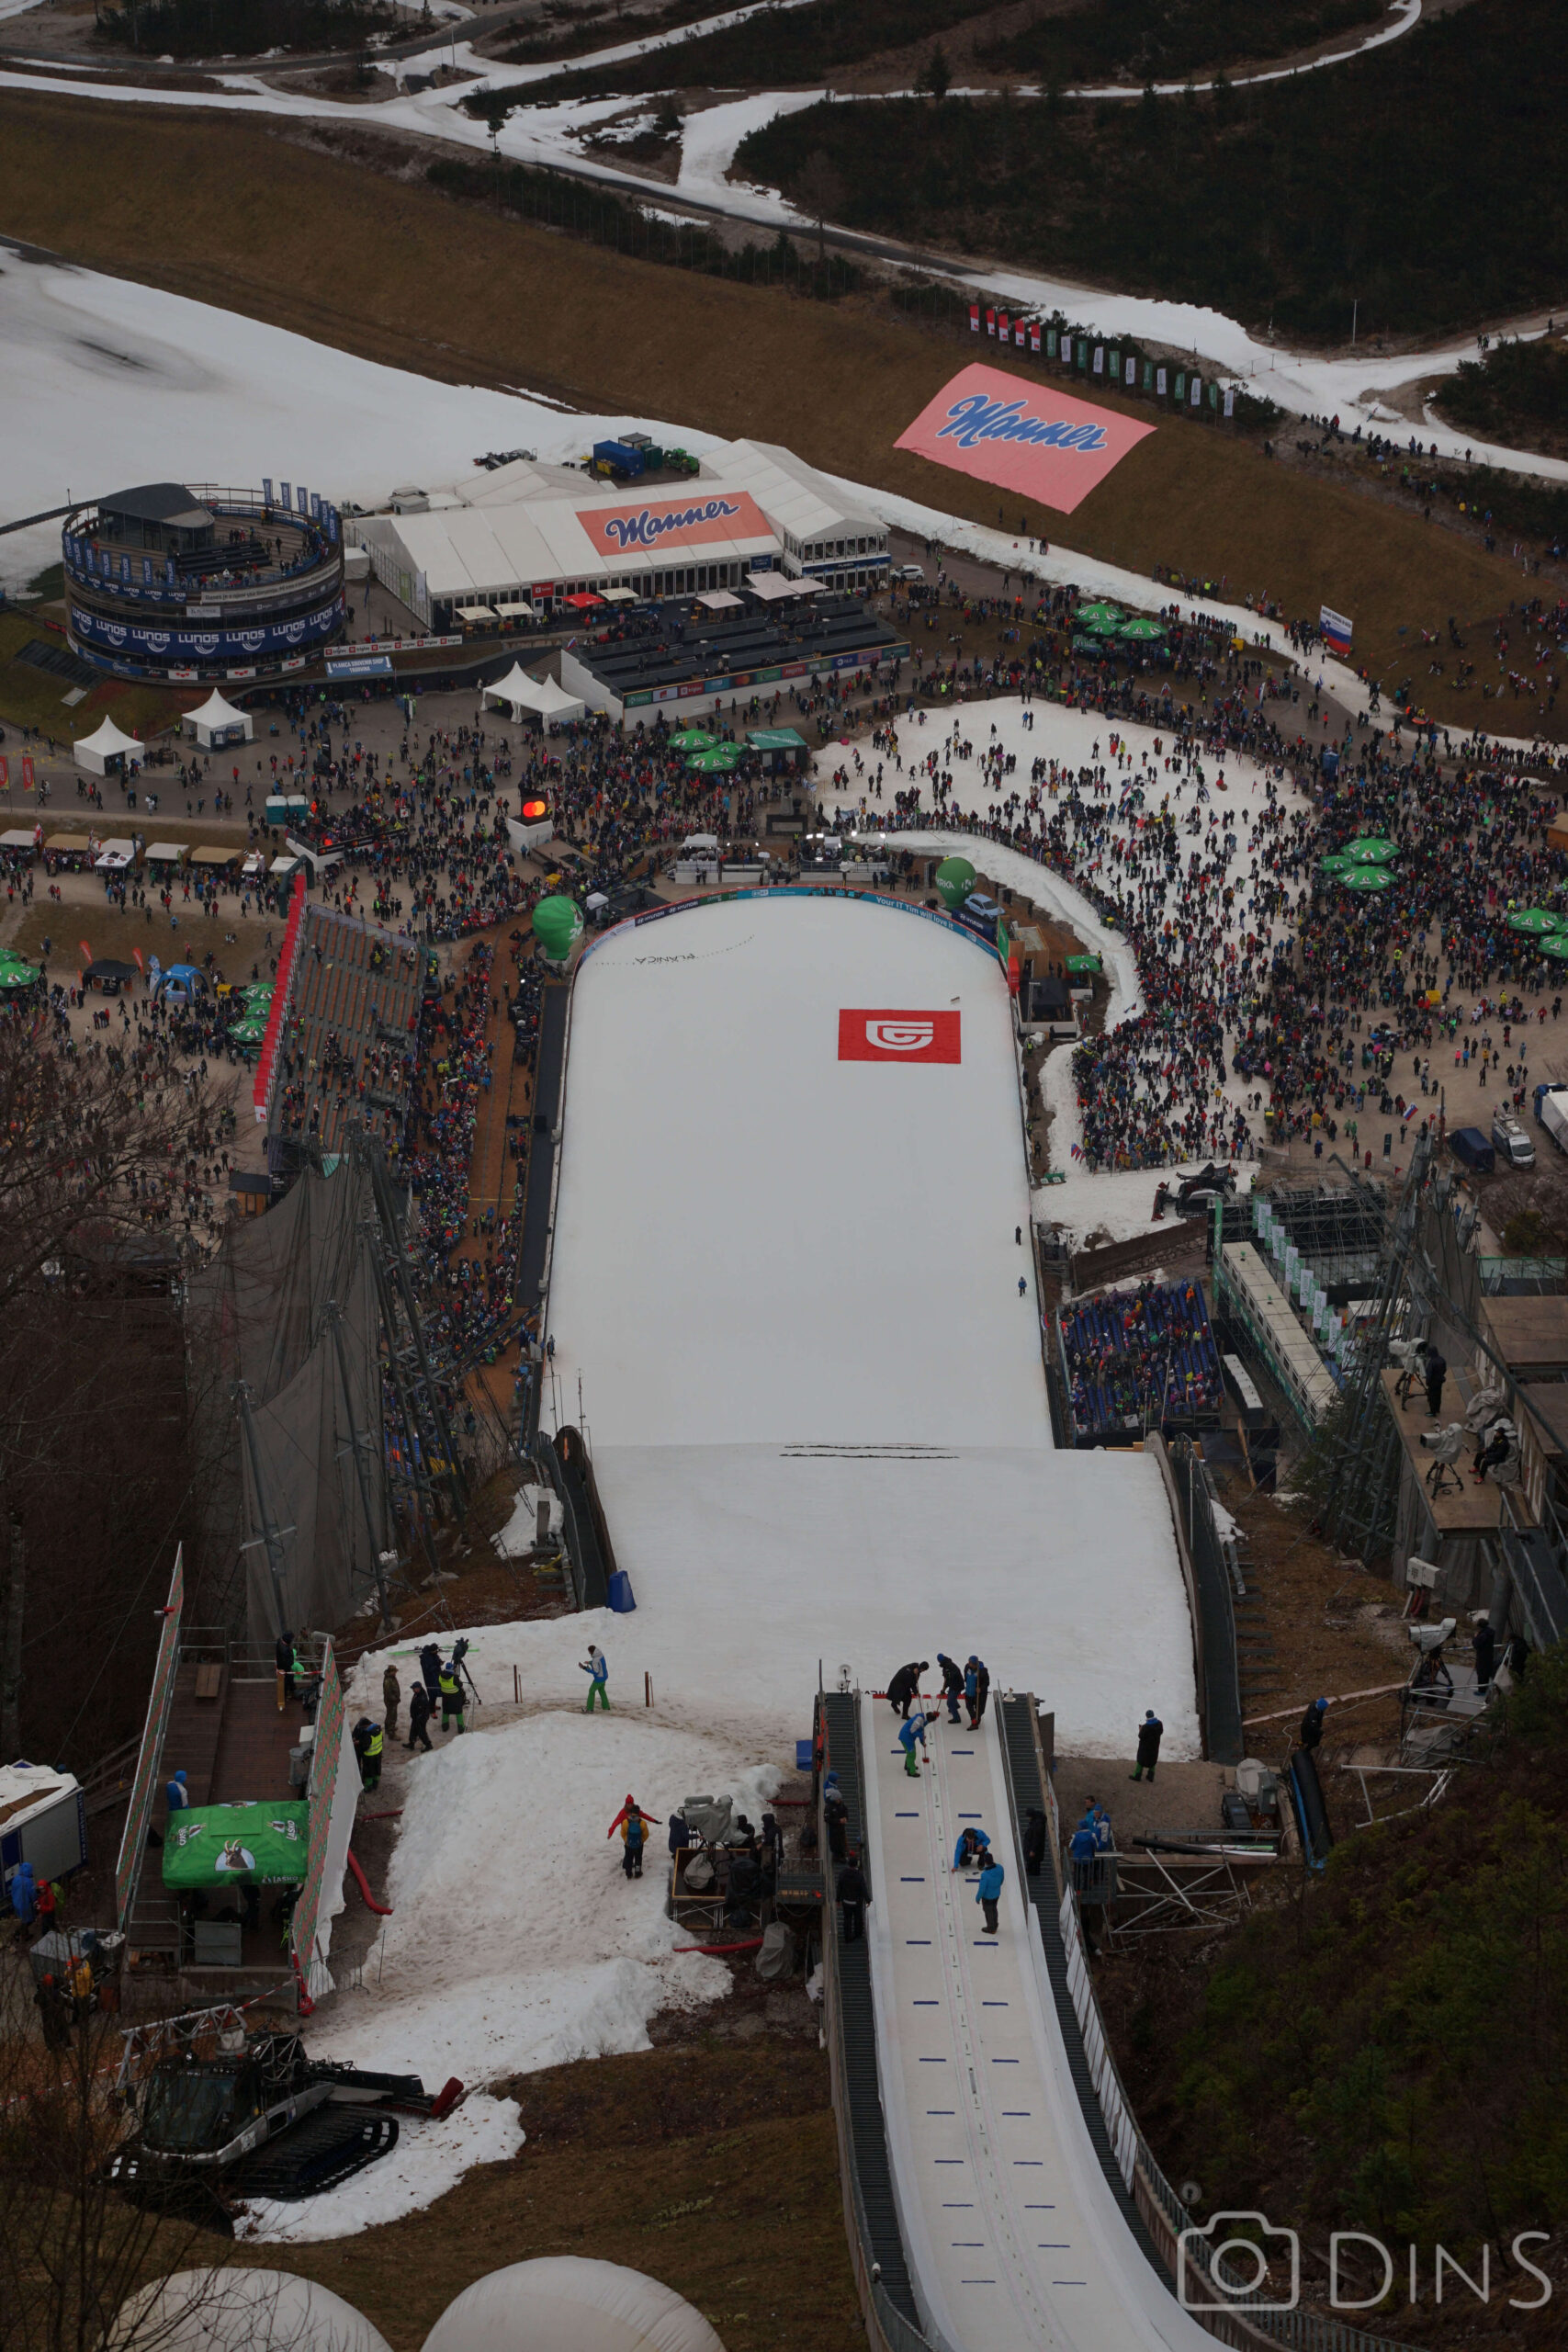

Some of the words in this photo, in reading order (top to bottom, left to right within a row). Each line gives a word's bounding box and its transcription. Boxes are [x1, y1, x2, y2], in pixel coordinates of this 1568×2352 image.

[936, 394, 1108, 452] Manner
[605, 500, 739, 548] Manner
[310, 606, 333, 627] LUNOS
[96, 620, 128, 637] LUNOS
[132, 628, 171, 642] LUNOS
[226, 628, 265, 642] LUNOS
[272, 619, 306, 637] LUNOS
[178, 633, 220, 643] LUNOS
[876, 897, 894, 907] Your
[896, 900, 904, 909] IT
[905, 904, 919, 914] Tim
[920, 909, 932, 920] will
[933, 915, 948, 927] love
[948, 922, 953, 930] it
